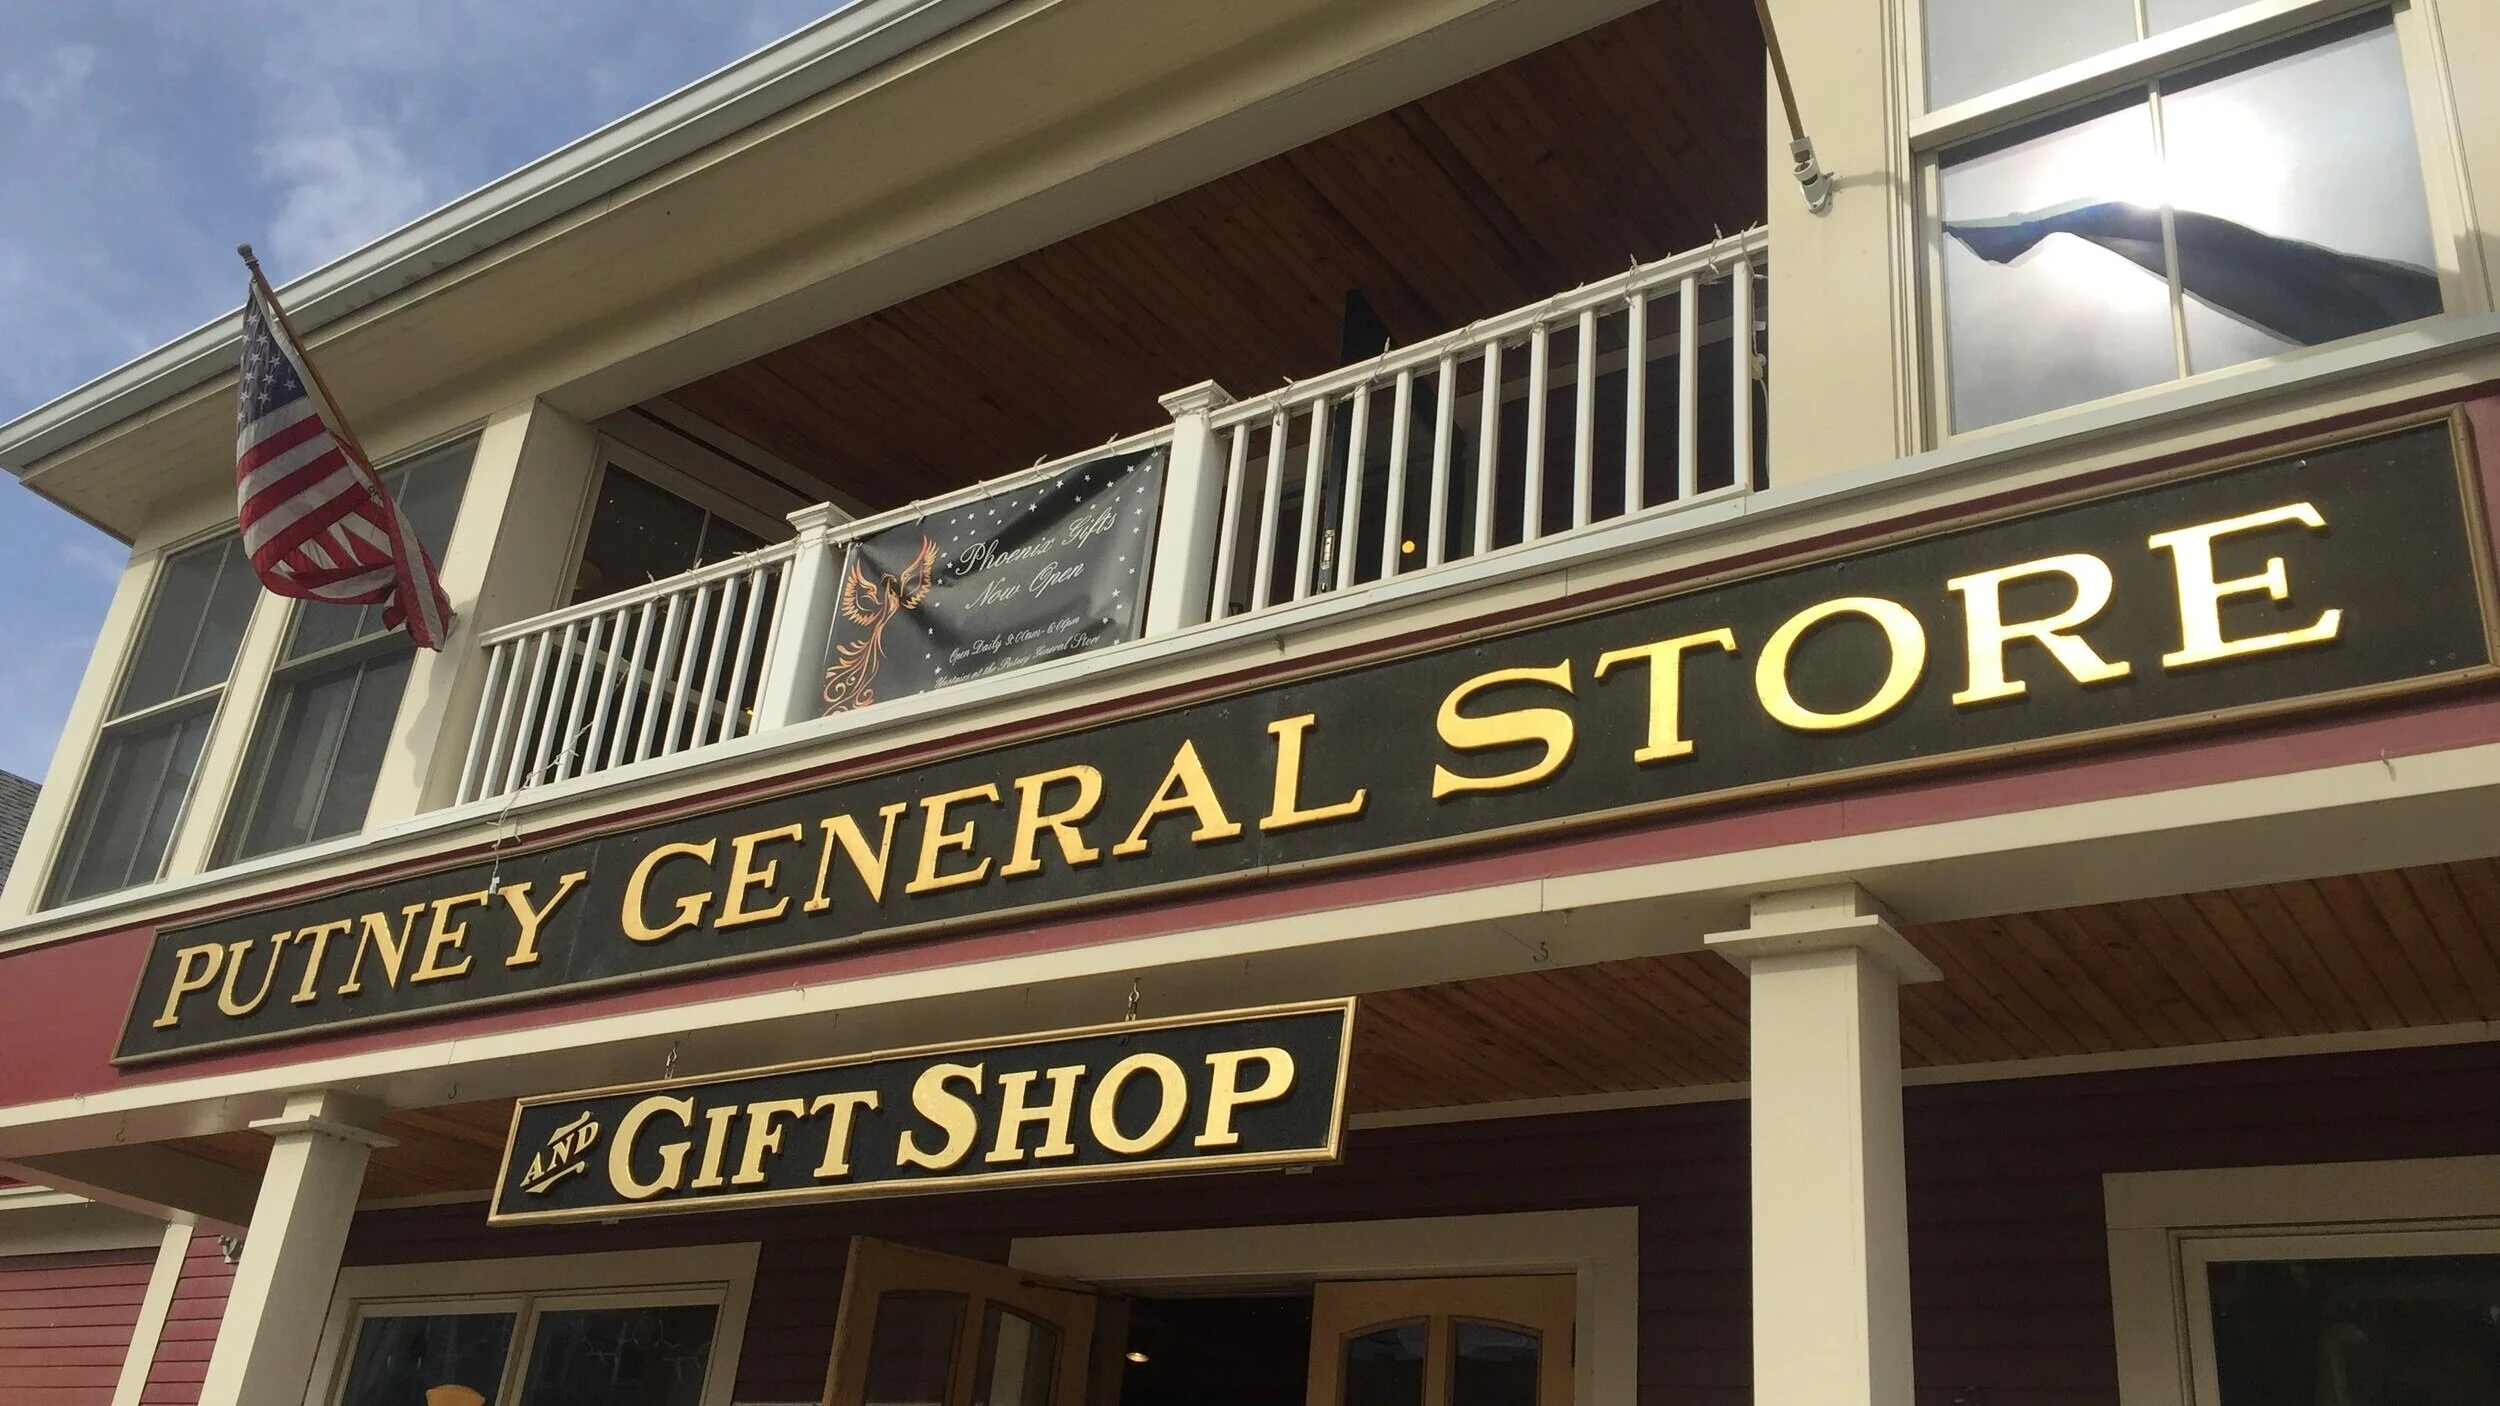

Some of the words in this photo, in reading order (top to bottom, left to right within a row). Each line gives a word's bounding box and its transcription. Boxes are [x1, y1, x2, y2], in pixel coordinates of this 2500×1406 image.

[955, 537, 1055, 575] Phoenix
[1061, 506, 1118, 549] Gifts
[965, 577, 1021, 609] Now
[1029, 561, 1085, 598] Open
[949, 647, 969, 666] Open
[971, 634, 1002, 654] Daily
[1071, 632, 1100, 649] Store
[153, 871, 587, 1028] PUTNEY
[621, 713, 1367, 942] GENERAL
[1432, 502, 2344, 799] STORE
[519, 1120, 600, 1188] AND
[608, 1090, 881, 1199] GIFT
[896, 1046, 1297, 1170] SHOP
